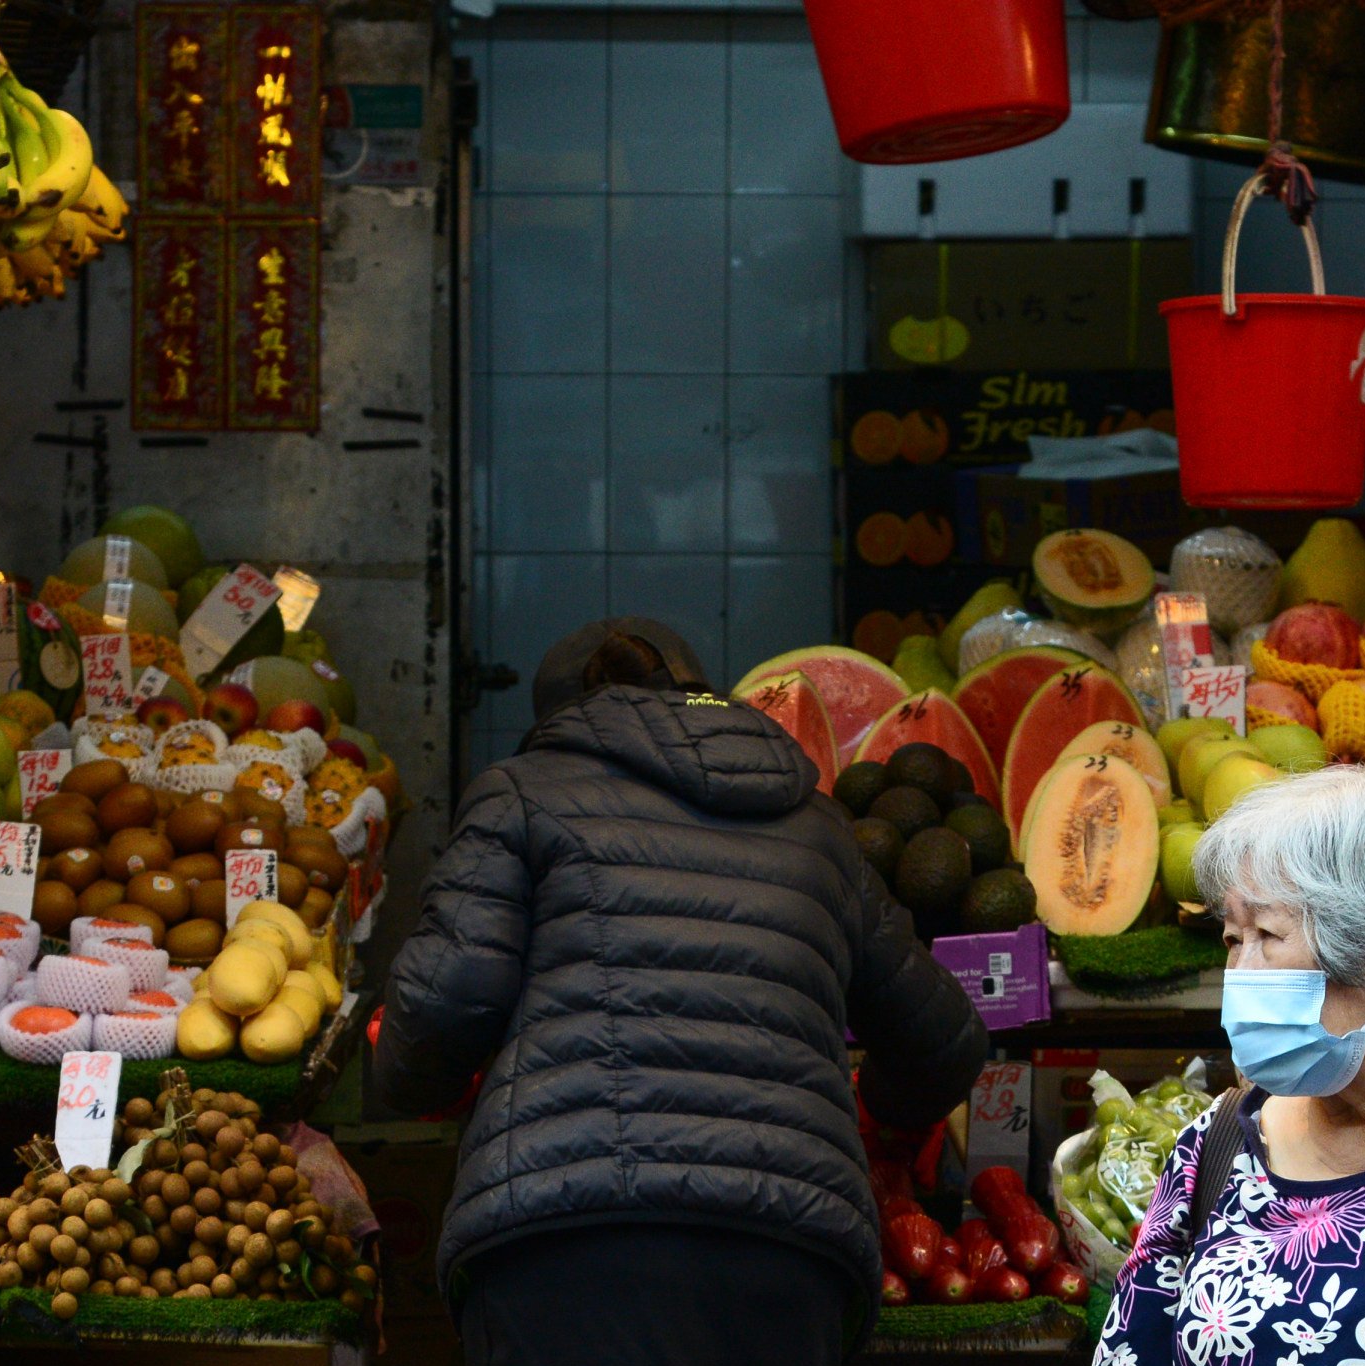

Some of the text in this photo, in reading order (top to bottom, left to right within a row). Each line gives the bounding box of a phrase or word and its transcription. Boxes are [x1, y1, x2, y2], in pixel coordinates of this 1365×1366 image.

[252, 246, 291, 402] 生意興隆
[978, 371, 1070, 411] Sim
[959, 407, 1089, 453] Fresh
[1110, 721, 1135, 741] 23
[1082, 754, 1110, 773] 23
